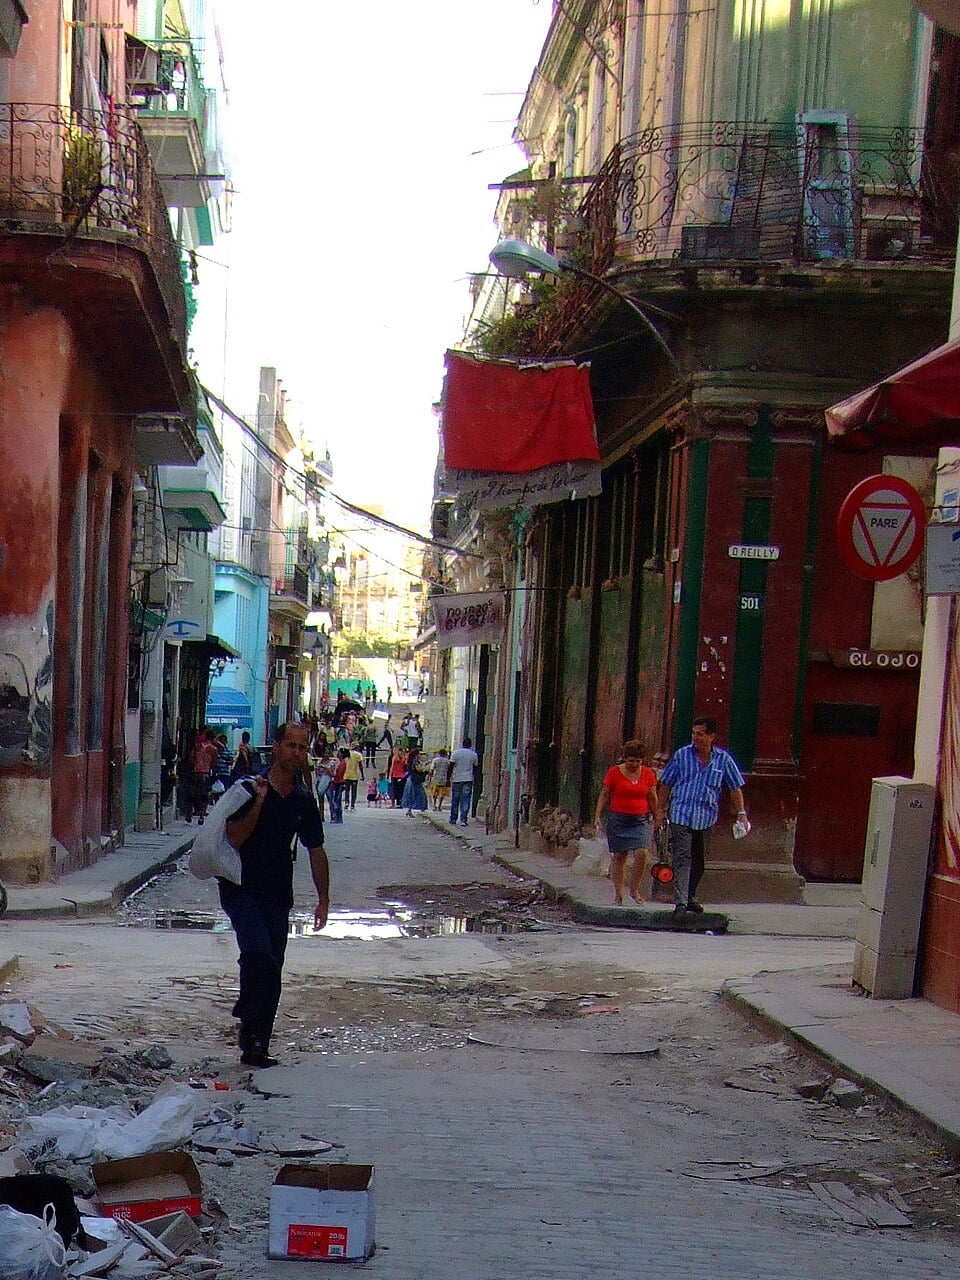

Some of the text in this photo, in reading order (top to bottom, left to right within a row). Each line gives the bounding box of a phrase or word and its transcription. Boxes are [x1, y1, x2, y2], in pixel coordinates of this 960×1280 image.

[870, 517, 899, 529] PARE
[741, 547, 775, 558] REILLY
[741, 597, 759, 610] 501
[876, 652, 919, 668] OJO
